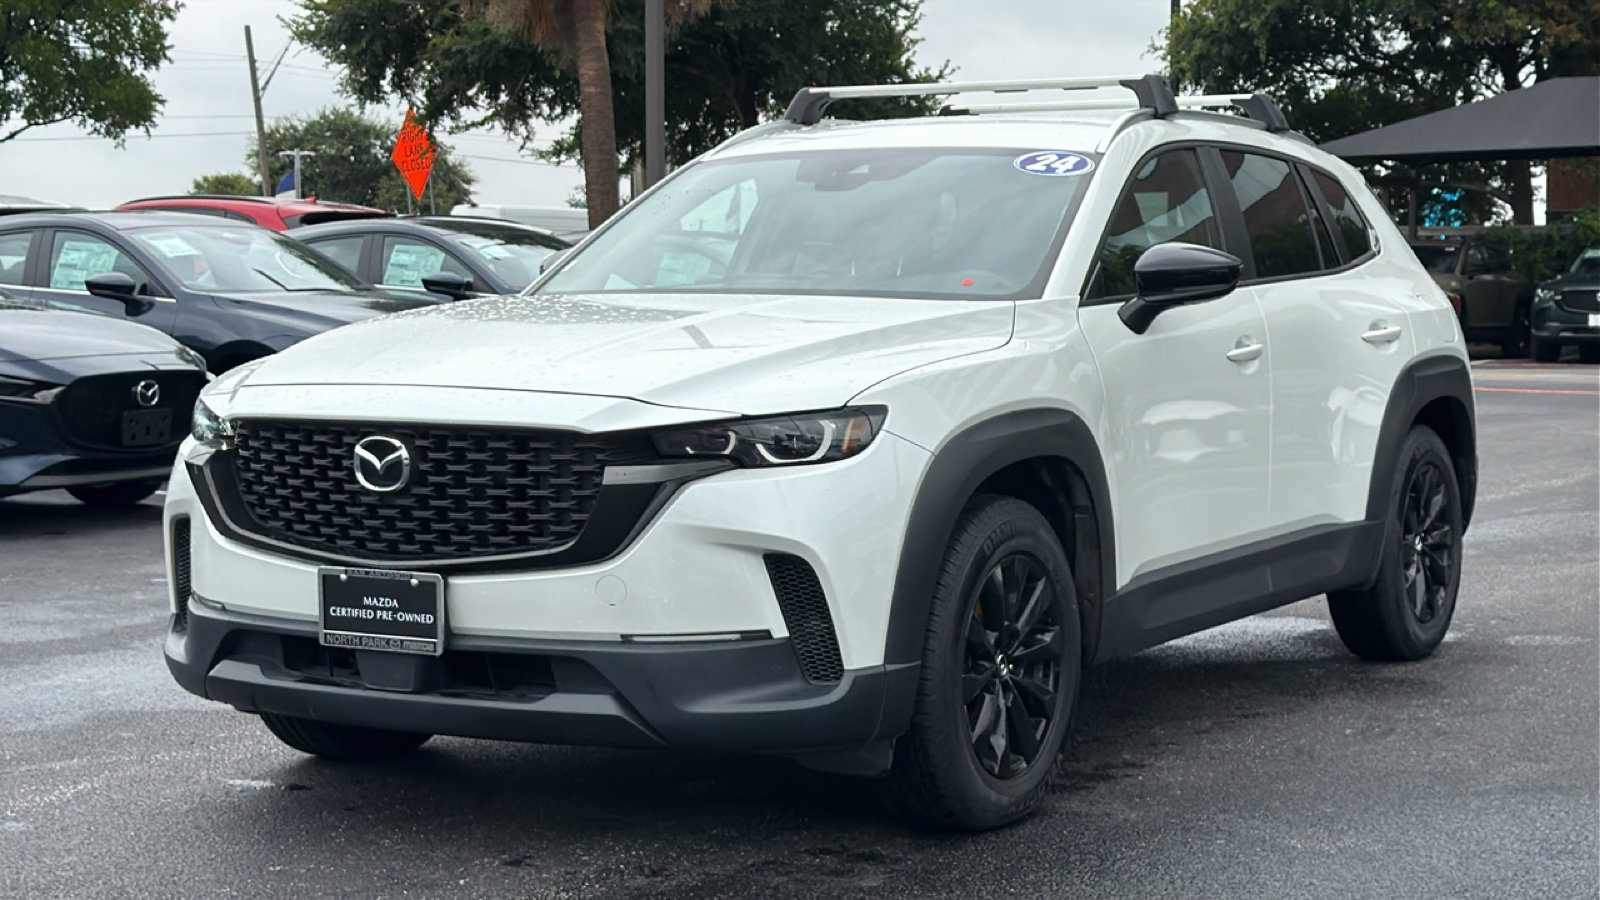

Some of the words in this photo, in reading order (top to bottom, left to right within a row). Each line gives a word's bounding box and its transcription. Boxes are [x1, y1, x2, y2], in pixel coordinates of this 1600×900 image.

[402, 157, 430, 172] CLOSED
[1026, 154, 1081, 174] 24
[363, 596, 399, 608] MAZDA
[330, 606, 374, 620] CERTIFIED
[376, 610, 434, 624] PRE-OWNED
[326, 634, 360, 646] NORTH
[362, 637, 388, 649] PARK
